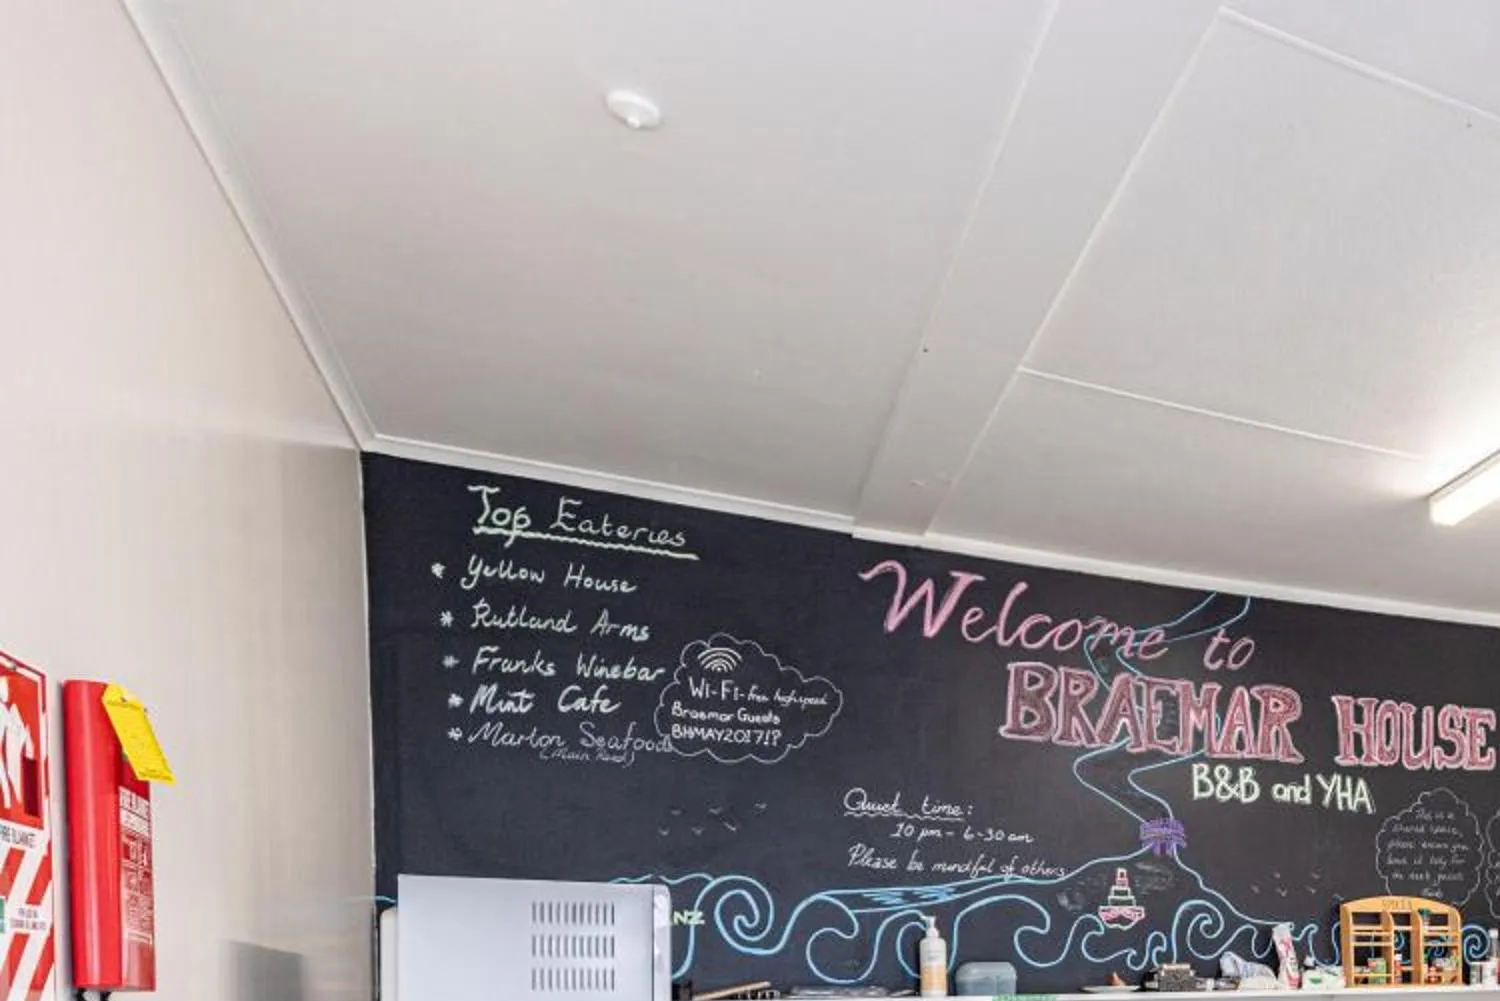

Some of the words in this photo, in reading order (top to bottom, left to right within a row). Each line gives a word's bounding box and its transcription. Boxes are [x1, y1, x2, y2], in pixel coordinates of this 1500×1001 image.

[469, 485, 532, 547] Top
[550, 495, 686, 547] Eateries
[460, 554, 545, 590] Yellow
[563, 561, 638, 593] House
[471, 597, 578, 633] Rutland
[590, 607, 650, 642] Arms
[858, 560, 1169, 661] Welcome
[1203, 627, 1256, 670] to
[557, 684, 622, 713] Cafe
[1000, 661, 1305, 764] BRAEMAR
[1332, 695, 1497, 771] HOUSE
[1191, 764, 1260, 803] B&B
[1272, 775, 1311, 803] and
[1314, 773, 1376, 815] YHA
[847, 842, 898, 869] Please
